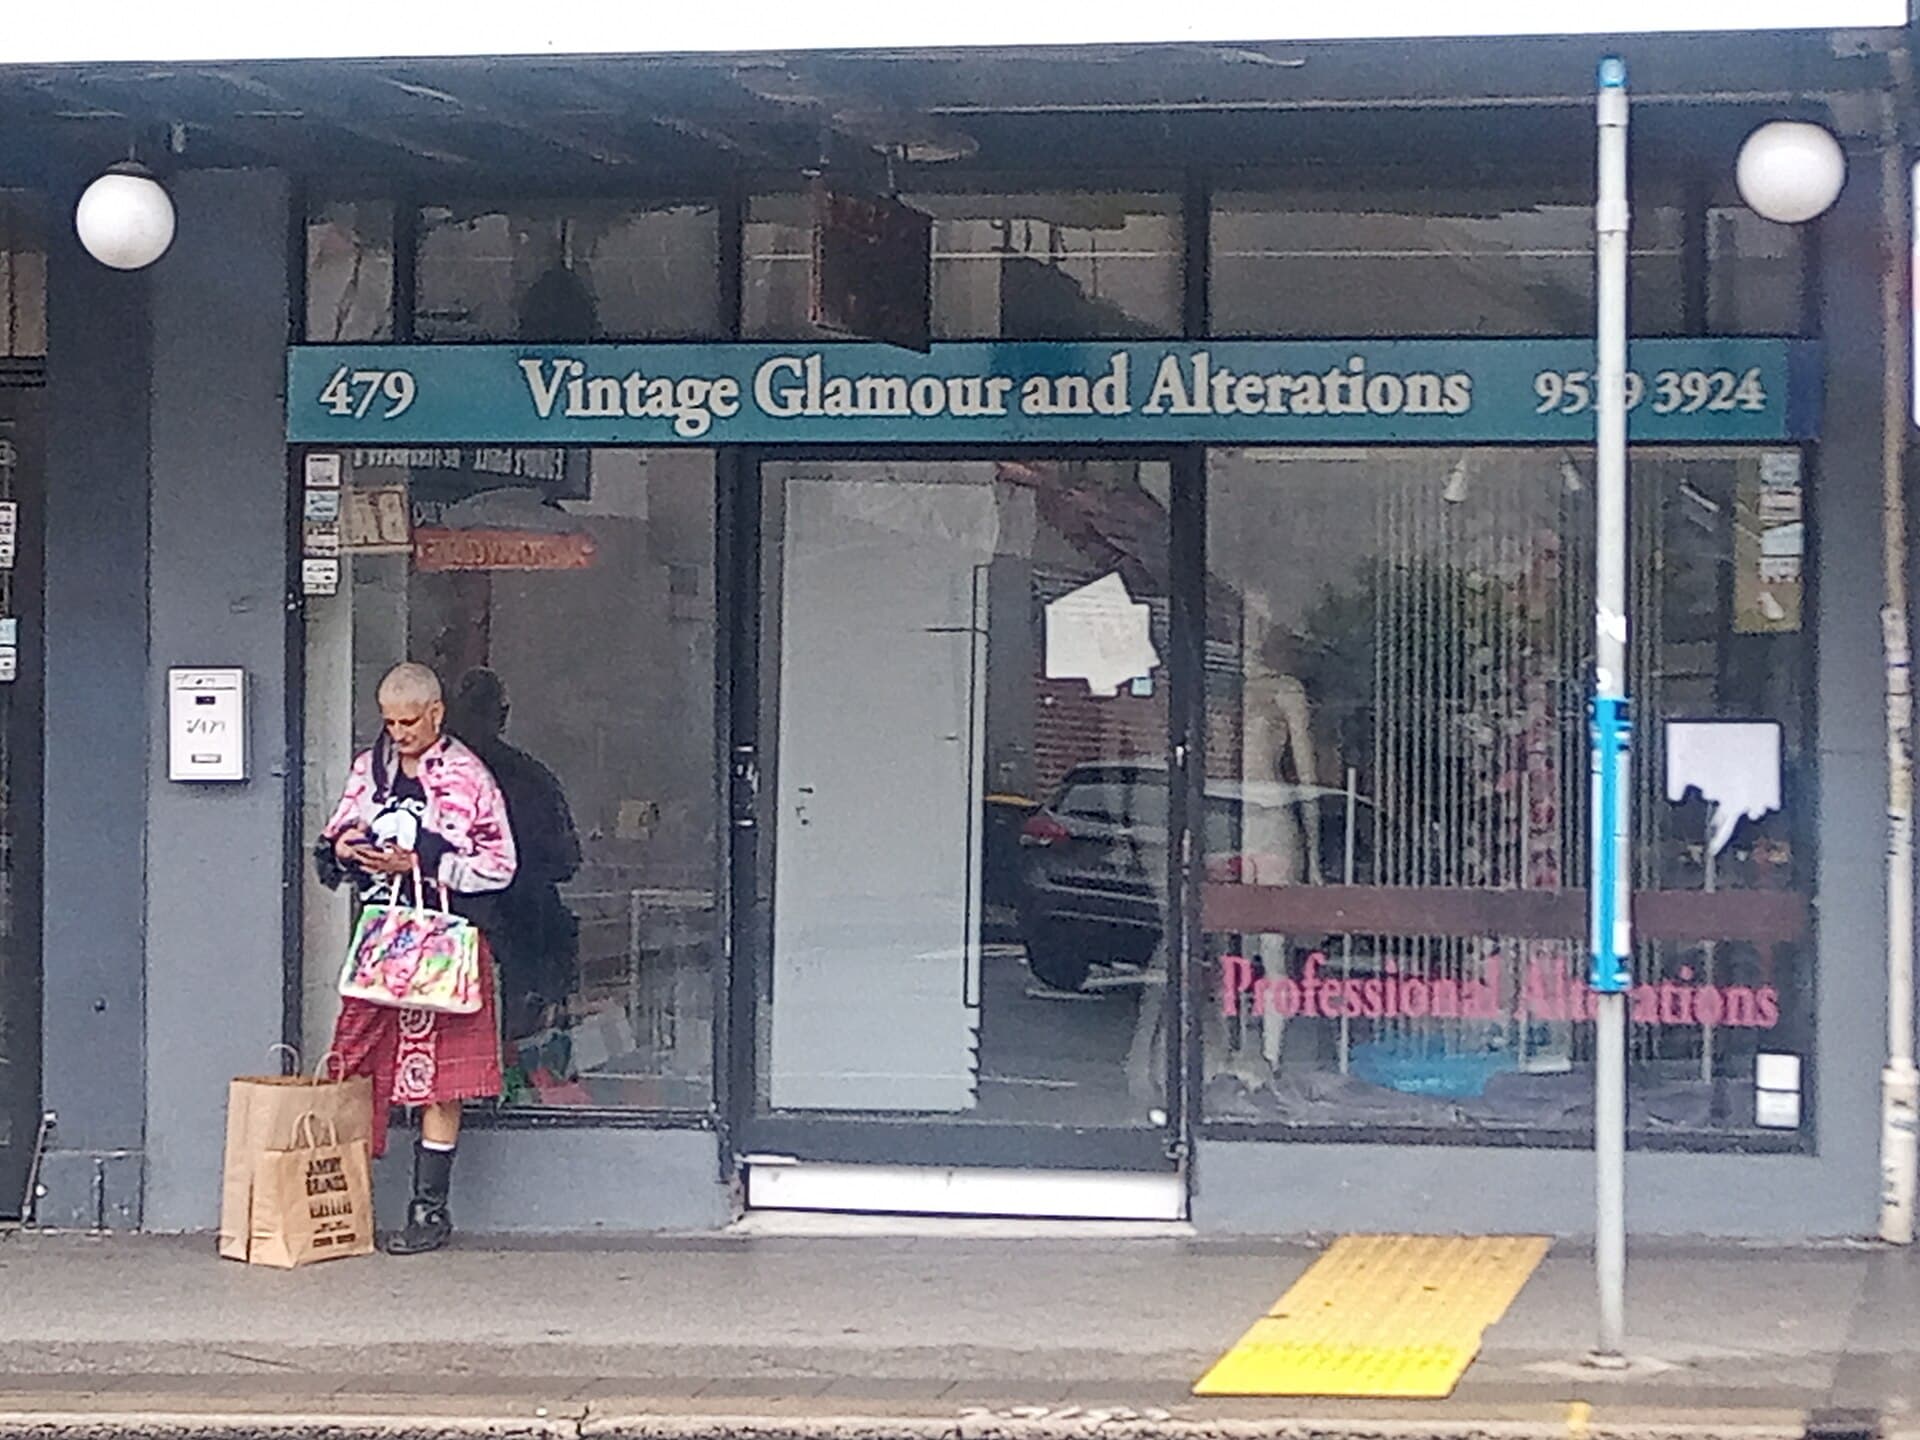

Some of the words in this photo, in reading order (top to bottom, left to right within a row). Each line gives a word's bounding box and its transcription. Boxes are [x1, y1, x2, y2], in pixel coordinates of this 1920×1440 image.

[318, 366, 416, 420] 479
[518, 358, 740, 437] Vintage
[753, 353, 1012, 417] Glamour
[1021, 350, 1132, 416] and
[1141, 350, 1473, 416] Alterations
[1534, 369, 1645, 415] 959
[1651, 366, 1767, 415] 3924
[1219, 951, 1500, 1019] Professional
[1512, 954, 1779, 1029] Altations
